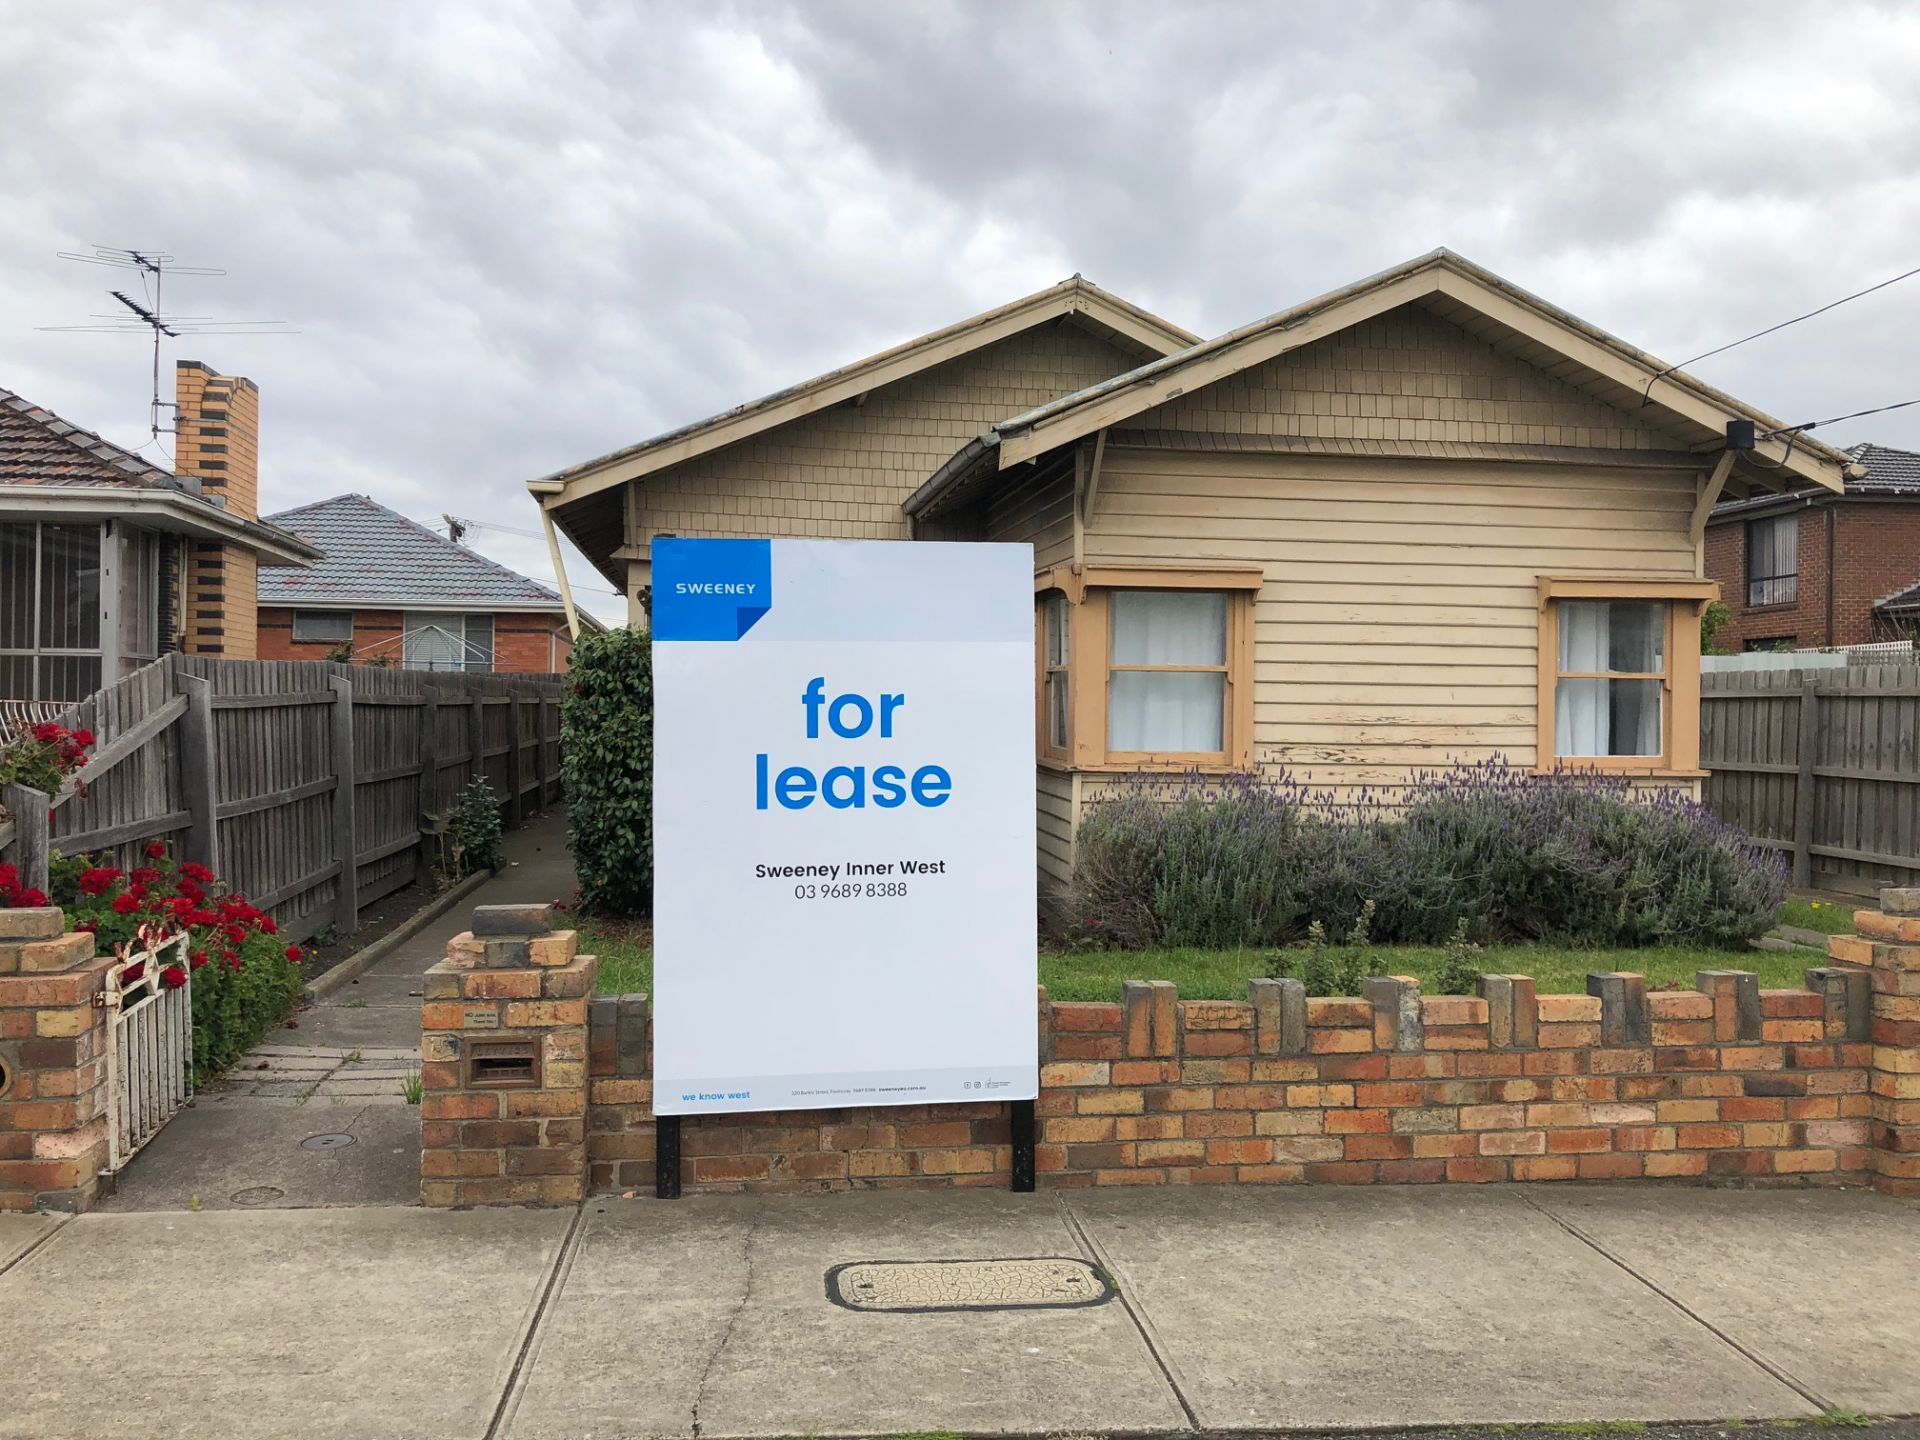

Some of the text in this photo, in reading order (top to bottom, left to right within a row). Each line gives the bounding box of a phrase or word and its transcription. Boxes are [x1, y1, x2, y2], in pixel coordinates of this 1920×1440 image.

[675, 582, 757, 595] SWEENEY
[801, 676, 905, 739] for
[755, 753, 953, 811] lease
[755, 859, 946, 881] Sweeney Inner West
[794, 882, 908, 900] 03 9689 8388
[682, 1091, 751, 1101] we know west
